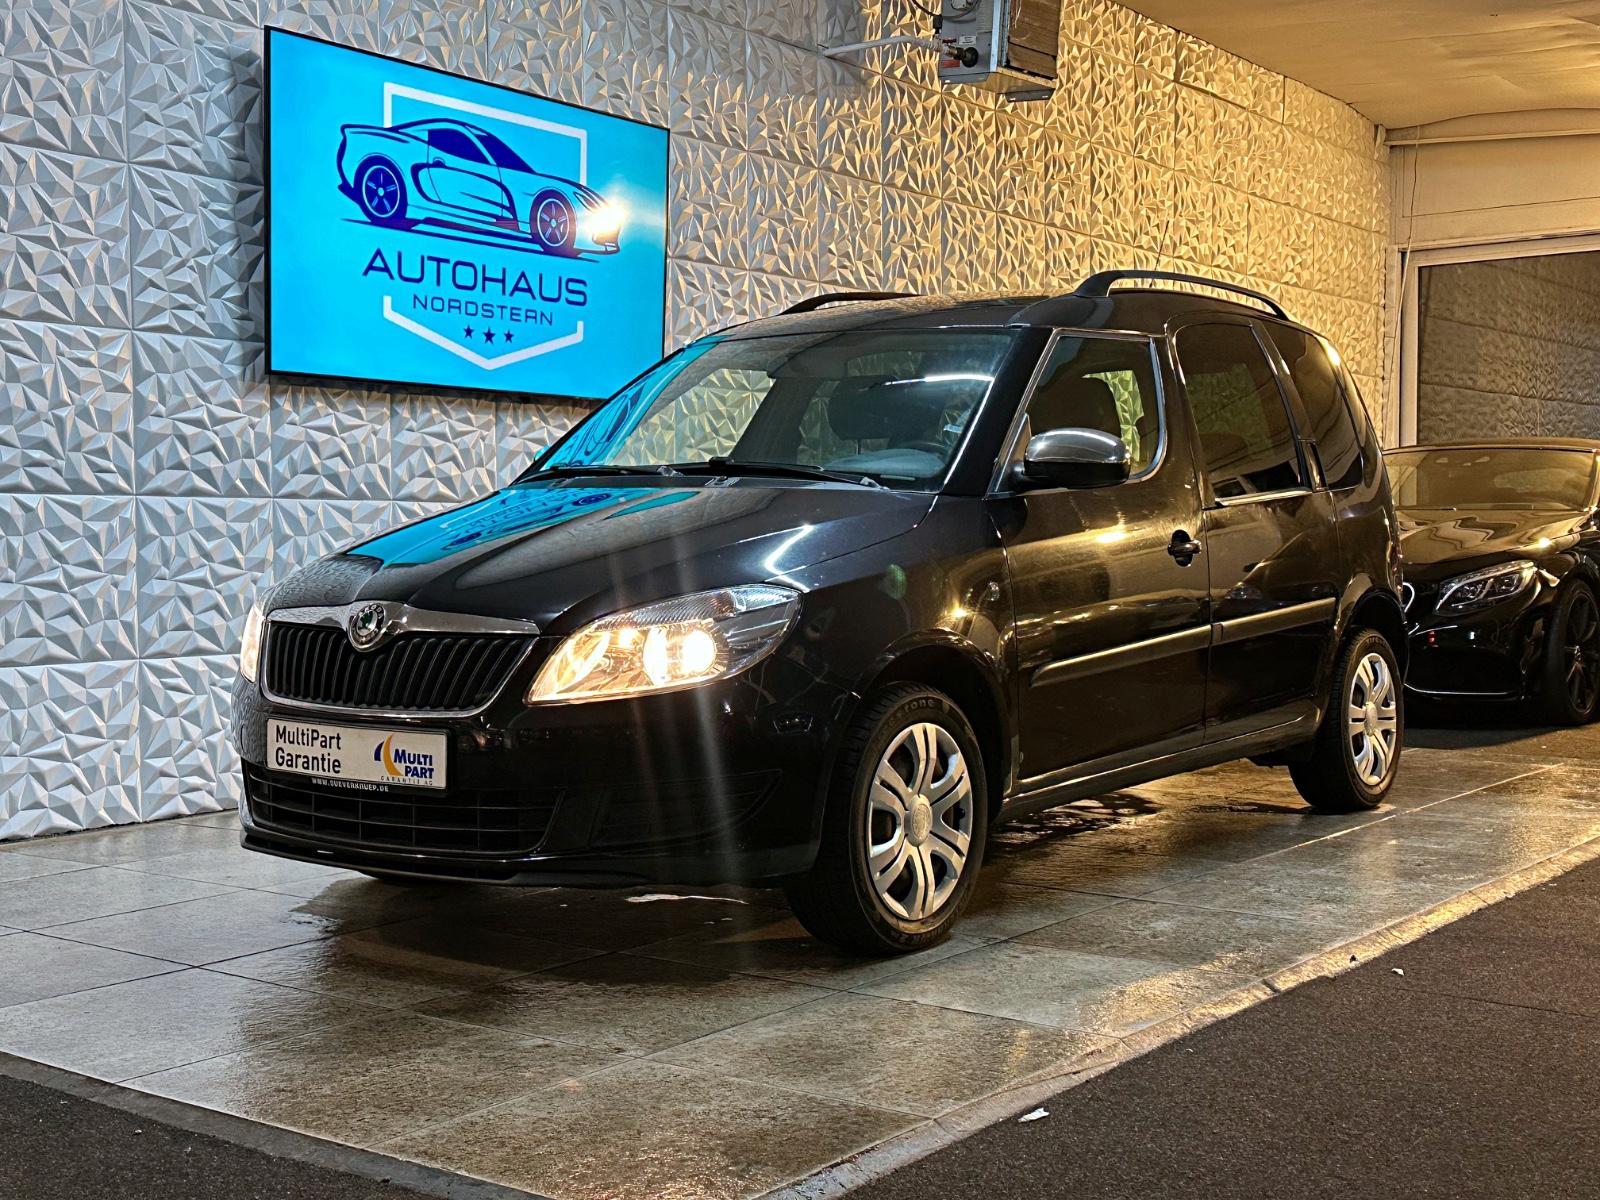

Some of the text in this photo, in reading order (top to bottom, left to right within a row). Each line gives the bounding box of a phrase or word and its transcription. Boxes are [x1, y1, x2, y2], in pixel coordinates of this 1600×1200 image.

[363, 248, 587, 306] AUTOHAUS
[413, 294, 553, 325] NORDSTERN
[276, 725, 341, 750] MultiPart
[275, 747, 341, 774] Garantie
[394, 748, 432, 766] MULTI
[405, 766, 434, 779] PART
